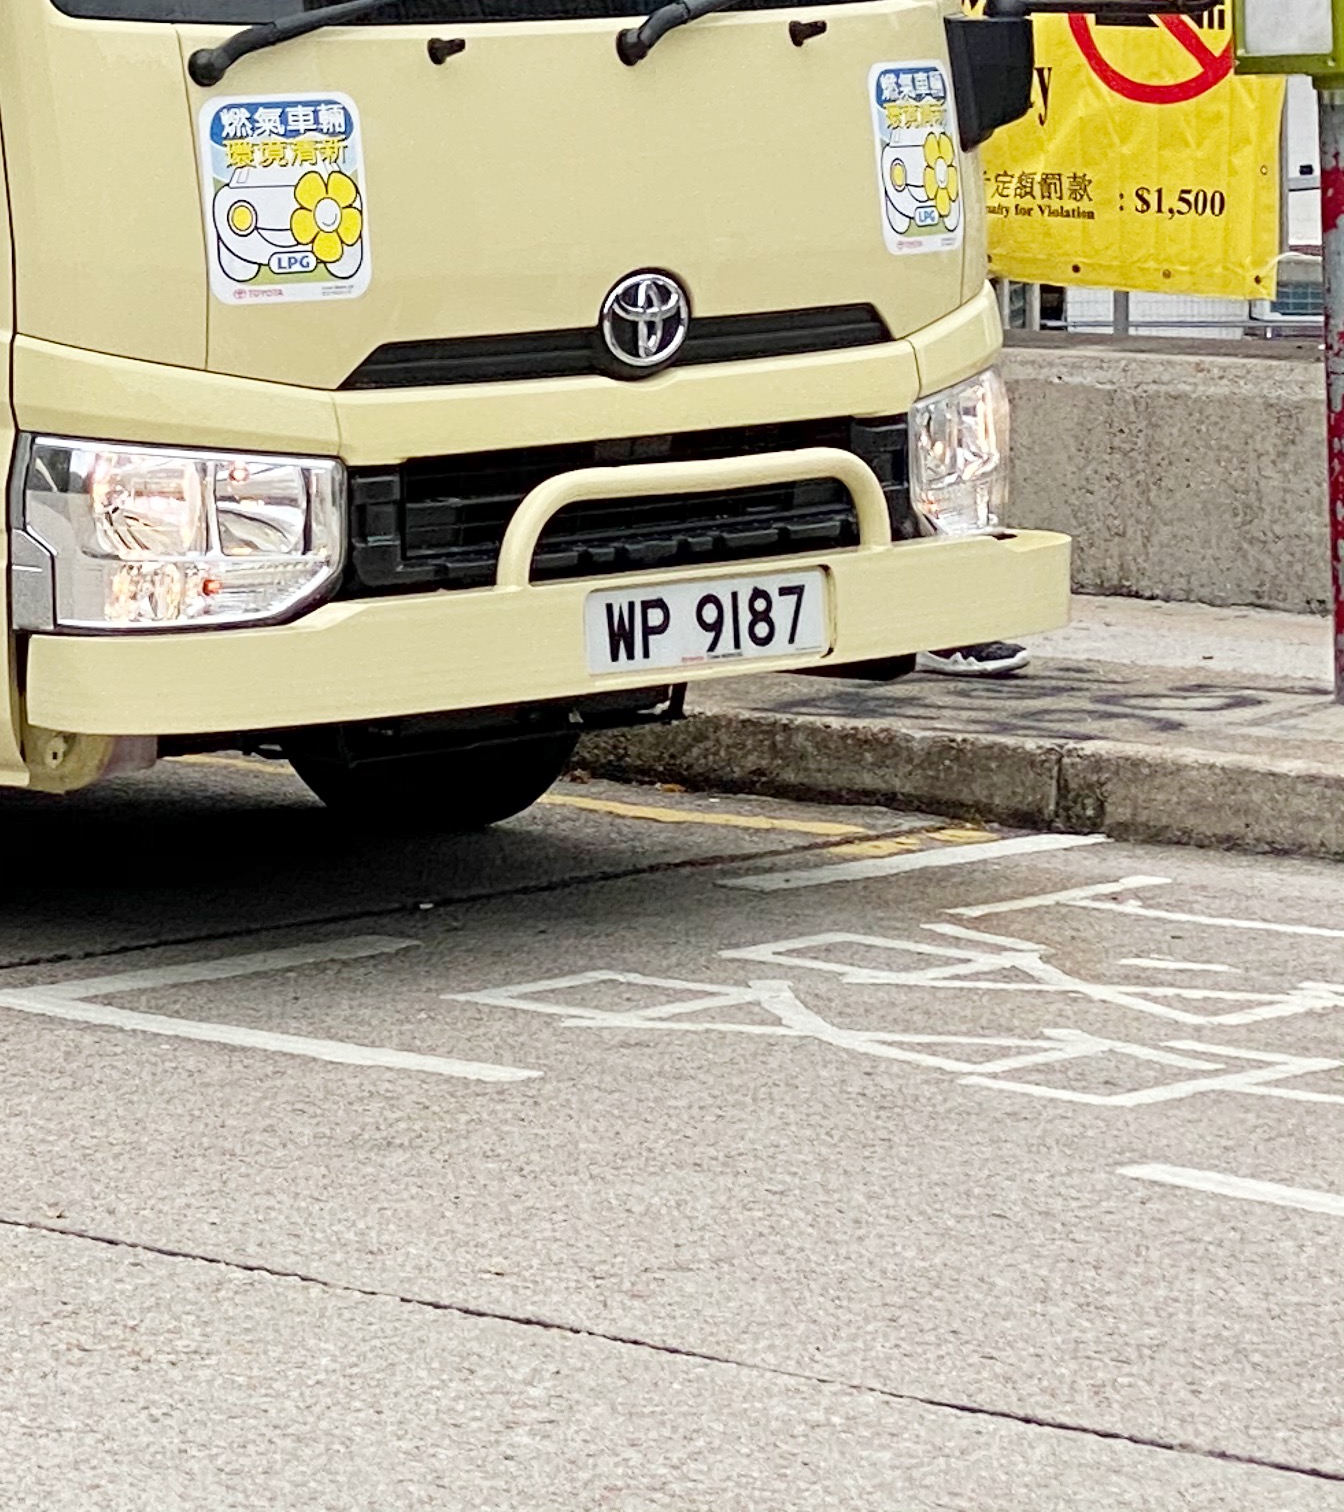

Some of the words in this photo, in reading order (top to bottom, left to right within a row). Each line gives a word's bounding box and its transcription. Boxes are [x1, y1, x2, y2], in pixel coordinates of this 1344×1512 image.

[220, 103, 347, 138] 燃氣車輛
[1014, 203, 1034, 217] for
[1037, 204, 1096, 220] Violation
[1135, 186, 1226, 220] $1,500
[276, 255, 311, 270] LPG
[605, 596, 671, 663] WP
[695, 584, 806, 653] 9187
